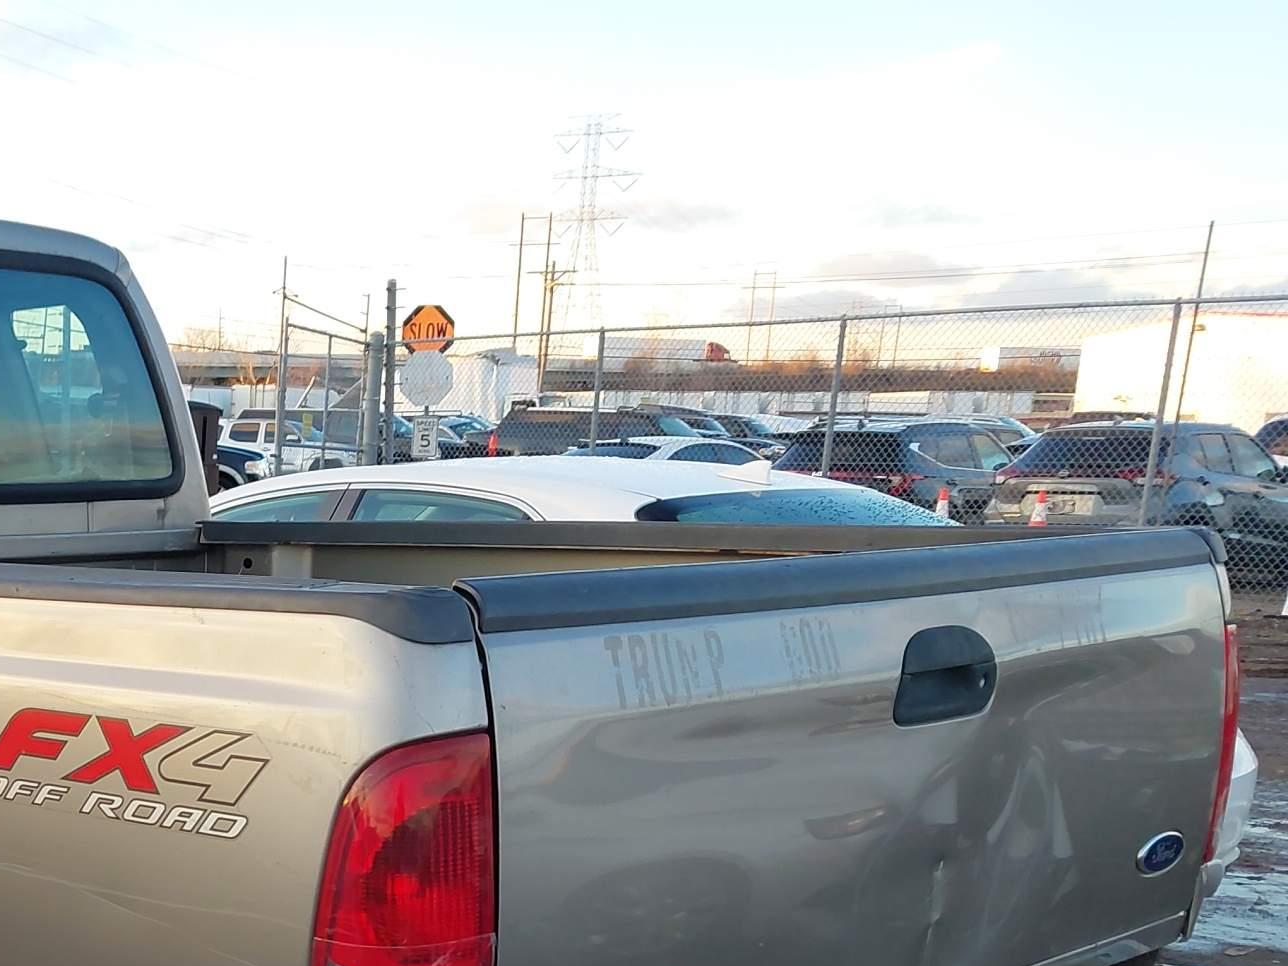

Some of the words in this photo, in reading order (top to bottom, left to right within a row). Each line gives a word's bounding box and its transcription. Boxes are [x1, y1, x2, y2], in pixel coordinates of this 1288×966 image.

[409, 322, 449, 340] SLOW
[420, 433, 431, 448] 5
[79, 791, 249, 839] ROAD
